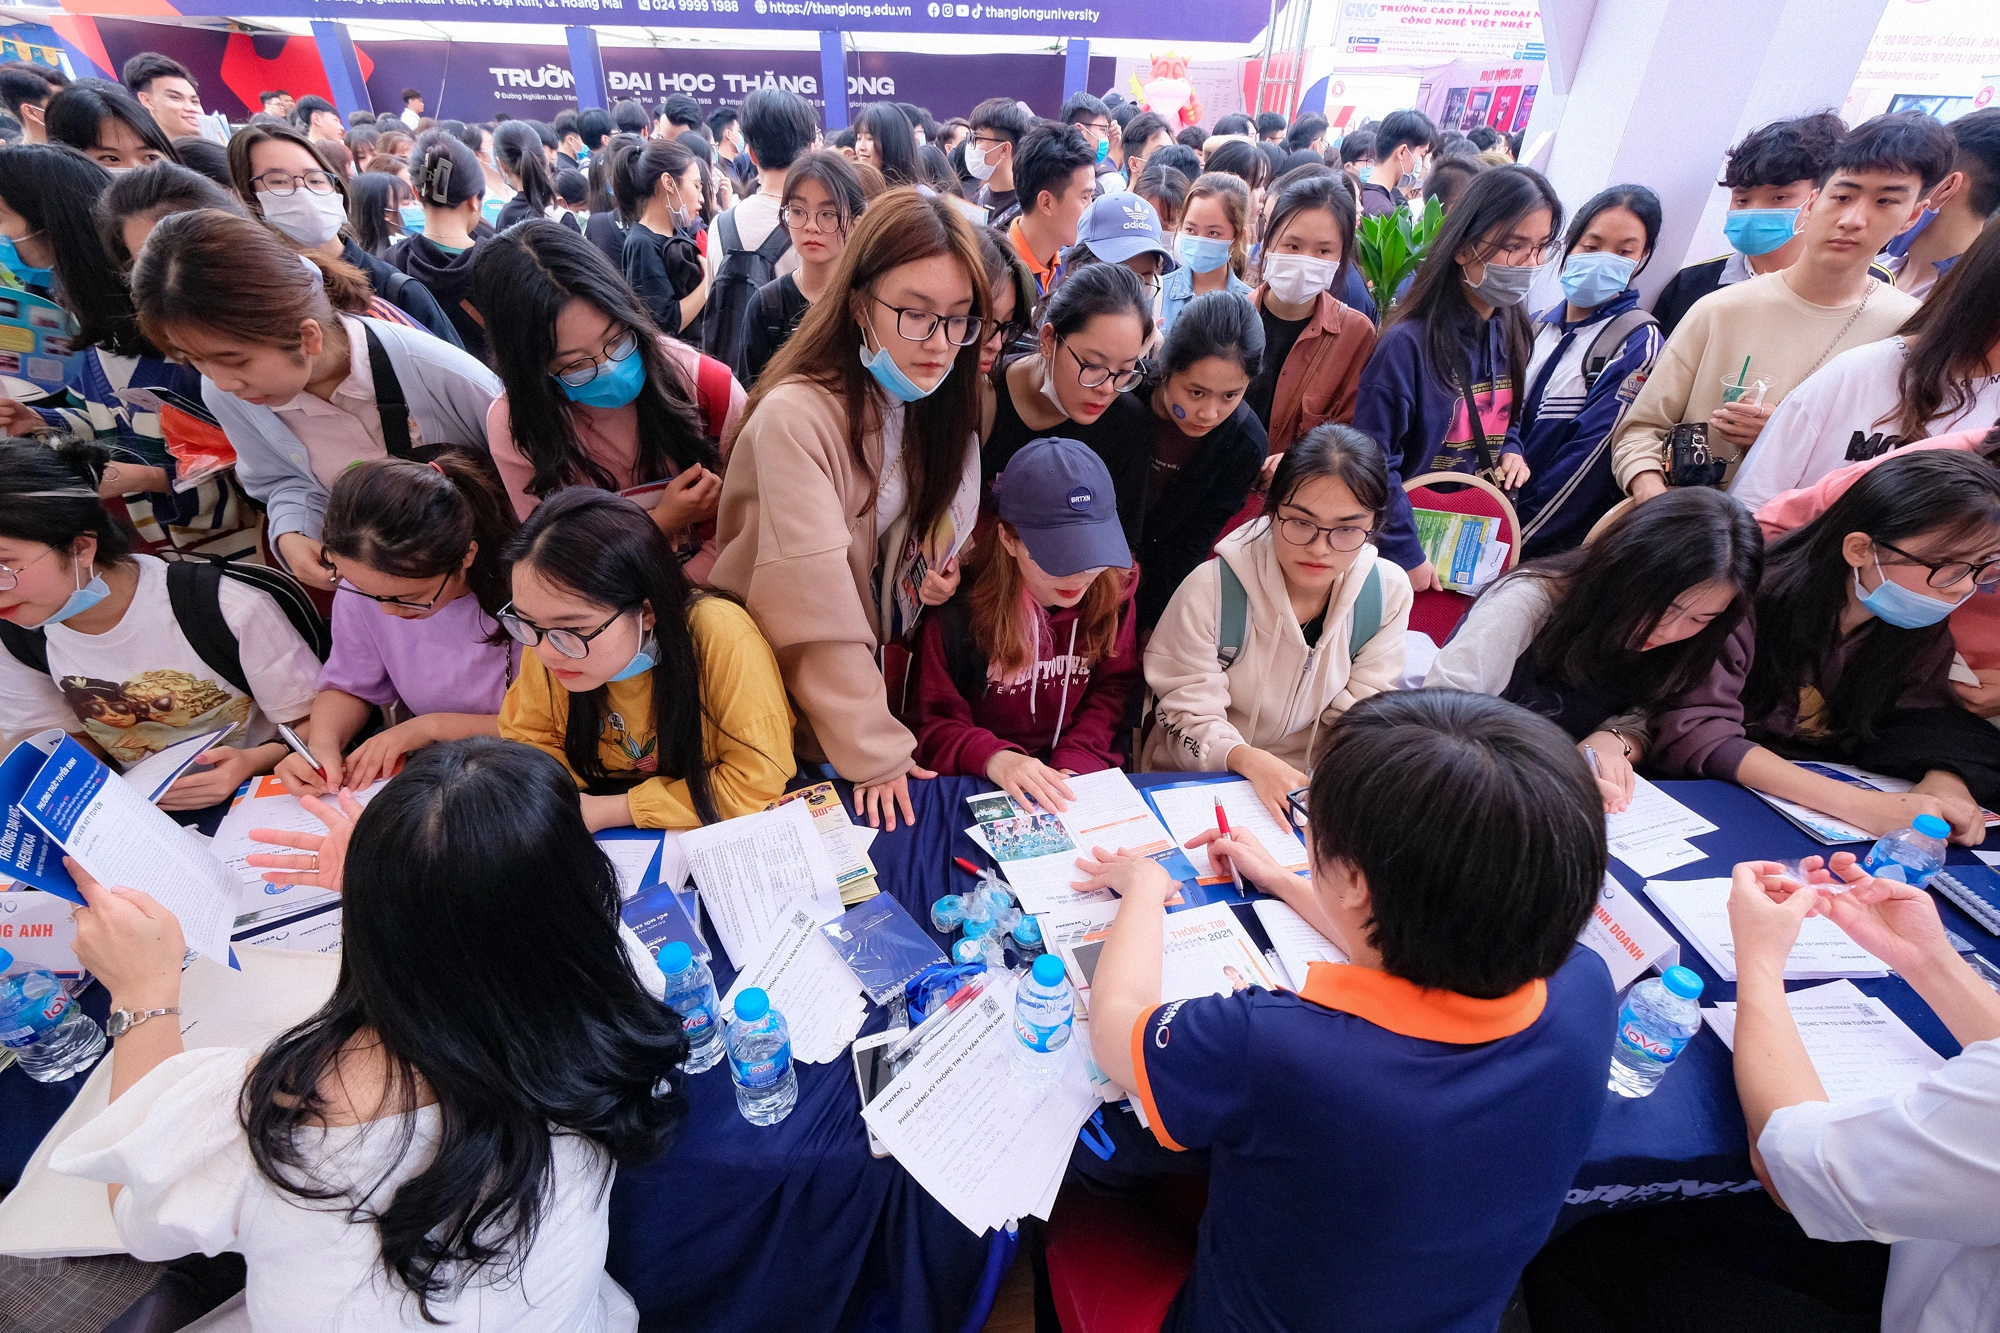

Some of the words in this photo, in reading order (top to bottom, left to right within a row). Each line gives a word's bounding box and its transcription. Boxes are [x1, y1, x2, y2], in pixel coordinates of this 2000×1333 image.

[654, 0, 676, 11] 024
[679, 0, 709, 12] 9999
[713, 0, 739, 13] 1988
[769, 1, 912, 18] https://thanglong.edu.vn
[985, 5, 1100, 23] thanglonguniversity
[1380, 4, 1428, 14] TRƯỜNG
[1494, 10, 1533, 18] NGOẠI
[1400, 15, 1432, 25] CÔNG
[1435, 18, 1468, 27] NGHỆ
[1471, 19, 1497, 28] VIỆT
[489, 64, 576, 88] TRƯỜN
[608, 71, 652, 95] ĐẠI
[658, 72, 716, 96] HỌC
[722, 70, 817, 94] THĂNG
[847, 76, 895, 95] ONG
[1123, 219, 1153, 232] adidas
[11, 831, 41, 871] PHENIKAA
[18, 923, 54, 938] ANH
[771, 927, 795, 951] PHENIKAA
[1169, 924, 1208, 940] THÔNG
[1208, 918, 1227, 932] TIN
[1207, 928, 1234, 942] 2021
[1593, 901, 1613, 930] INH
[1608, 924, 1646, 963] DOANH
[645, 935, 667, 947] PHENI
[776, 965, 787, 976] TIN
[804, 919, 818, 934] SINH
[939, 1041, 950, 1052] ĐẠI
[947, 1032, 960, 1045] HỌC
[955, 1011, 979, 1035] PHENIKAA
[895, 1105, 916, 1125] PHIẾU
[911, 1090, 931, 1108] ĐĂNG
[926, 1082, 937, 1093] KÝ
[932, 1064, 955, 1085] THÔNG
[951, 1055, 962, 1067] TIN
[958, 1047, 970, 1059] TƯ
[965, 1037, 980, 1052] VẤN
[974, 1021, 995, 1042] TUYỂN
[991, 1011, 1007, 1026] SINH
[877, 1086, 906, 1112] PHENIKAA
